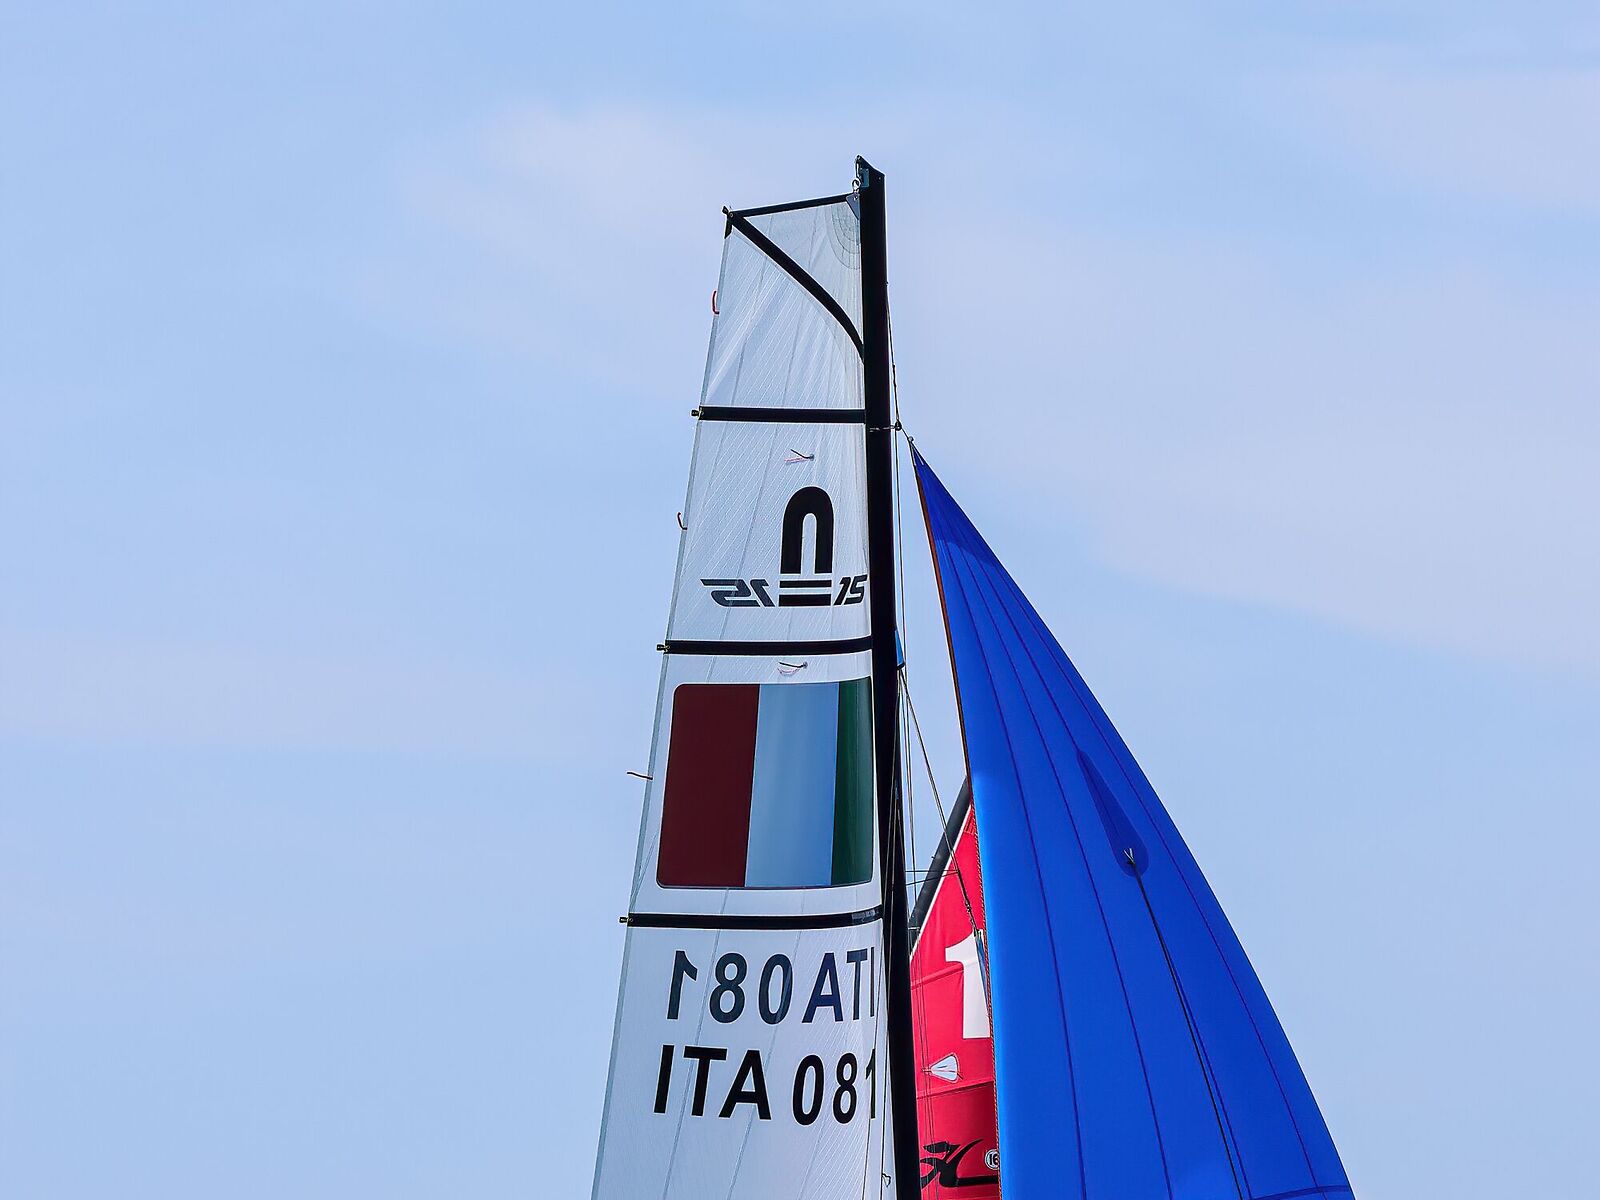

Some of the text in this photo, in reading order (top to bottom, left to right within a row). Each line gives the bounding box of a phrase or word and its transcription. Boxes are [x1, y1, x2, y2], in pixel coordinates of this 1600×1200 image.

[833, 573, 868, 606] 15
[653, 1044, 877, 1126] ITA 081
